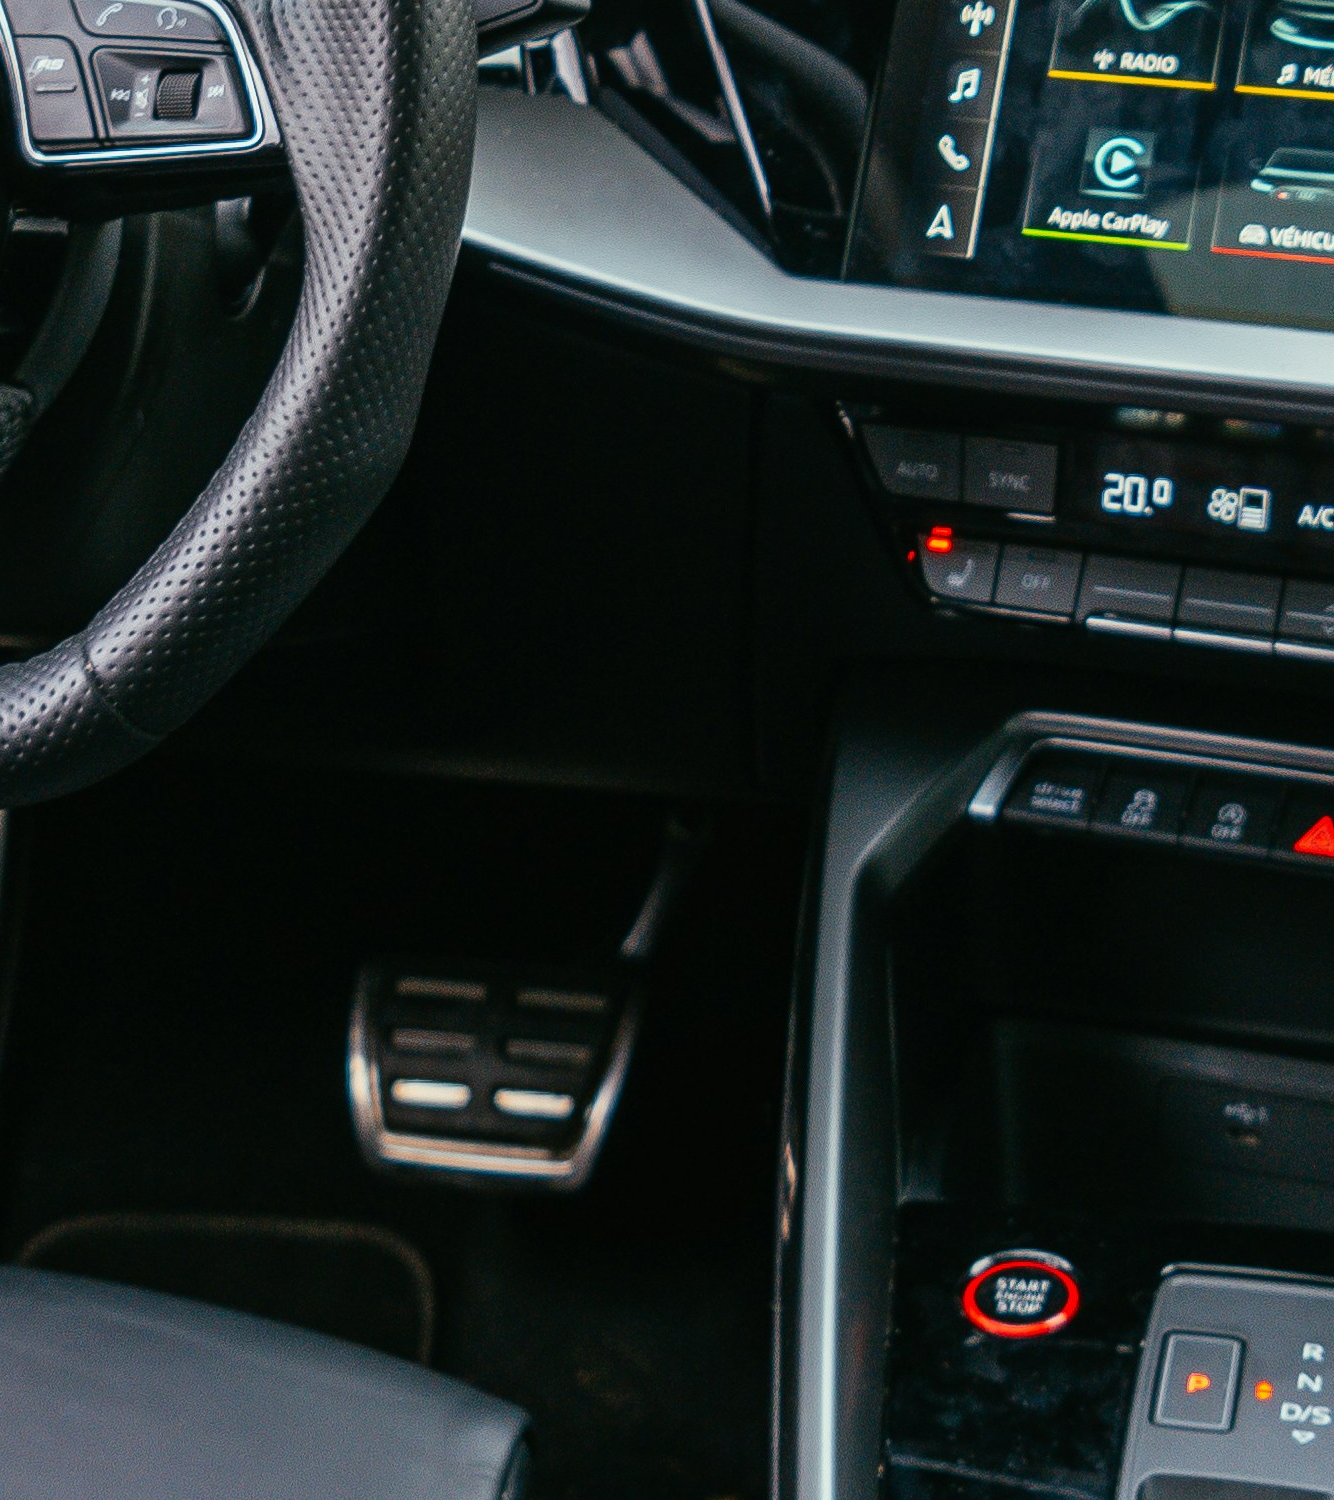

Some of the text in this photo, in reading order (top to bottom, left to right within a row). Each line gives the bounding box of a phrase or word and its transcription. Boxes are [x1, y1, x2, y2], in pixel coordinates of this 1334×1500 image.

[1120, 51, 1179, 74] RADIO
[1047, 206, 1170, 239] Apple CarPlay
[988, 472, 1030, 492] SYNC
[997, 1277, 1050, 1292] START
[996, 1301, 1042, 1315] STOP
[1303, 1342, 1324, 1362] R
[1186, 1373, 1211, 1393] P
[1297, 1372, 1323, 1392] N
[1279, 1401, 1333, 1426] D/S
